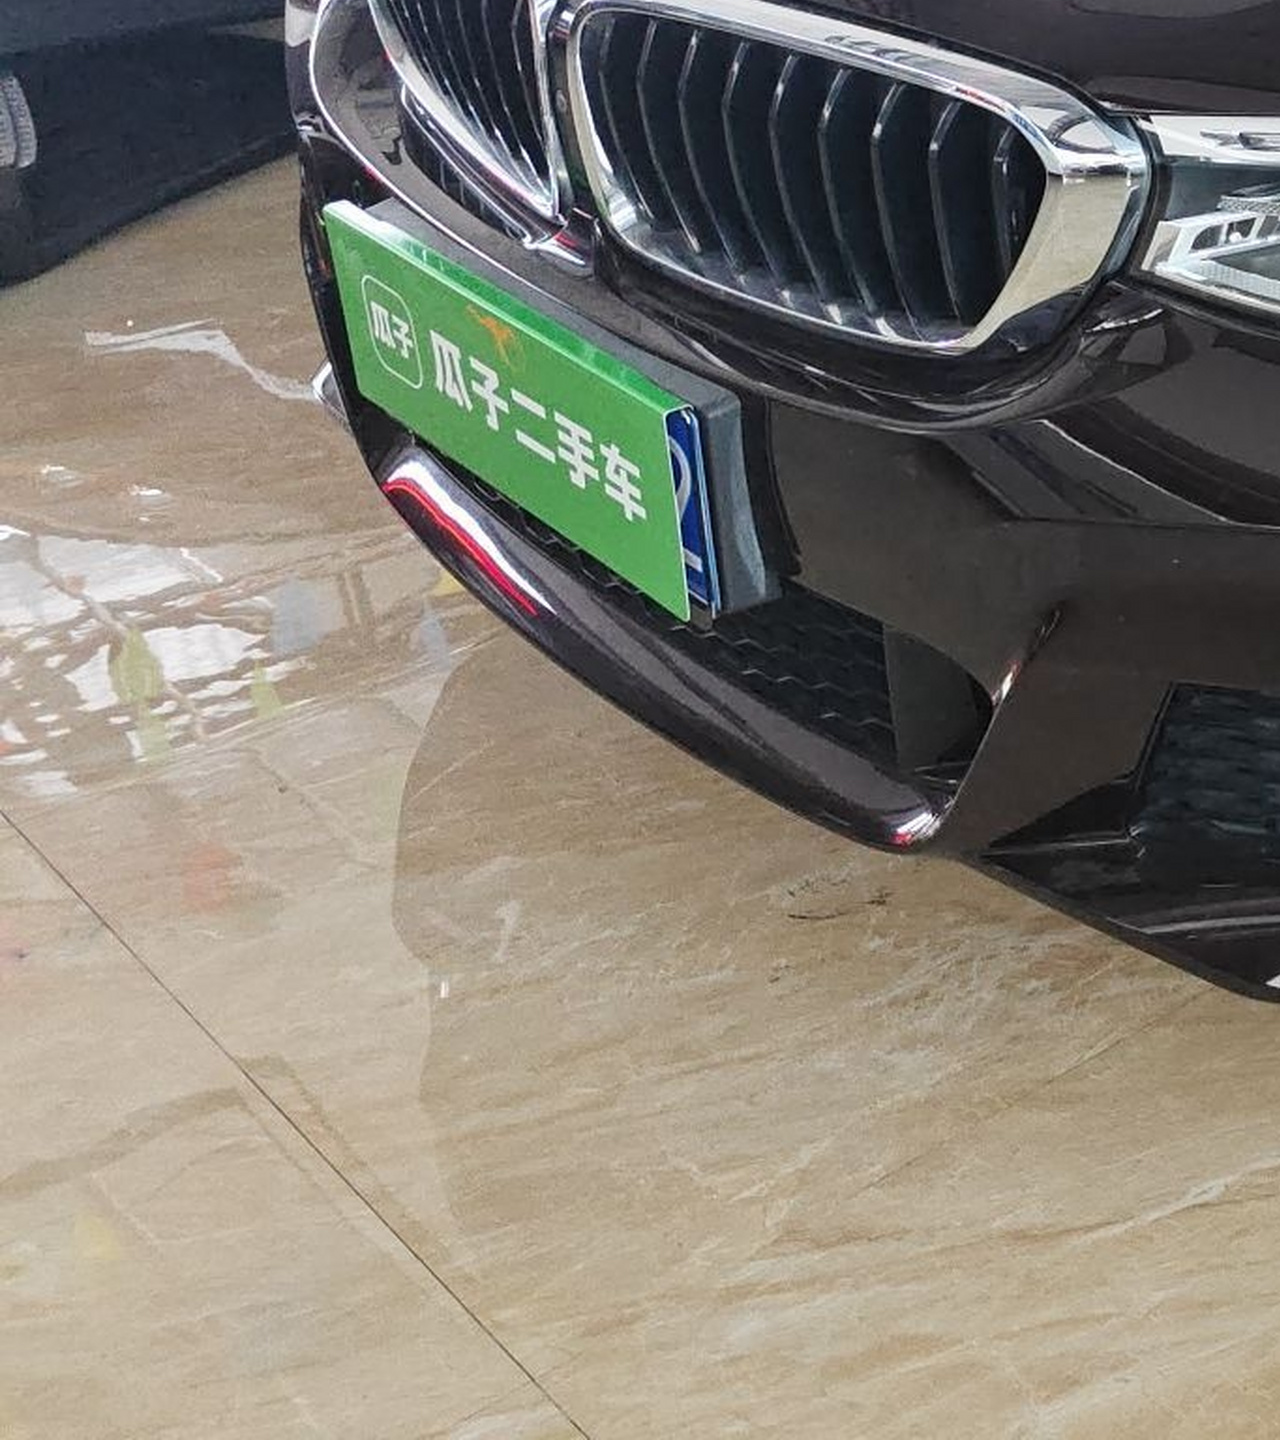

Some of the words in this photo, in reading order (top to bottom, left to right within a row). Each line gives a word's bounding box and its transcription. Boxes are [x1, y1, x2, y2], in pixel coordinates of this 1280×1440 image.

[369, 300, 414, 360] 瓜子
[430, 329, 647, 522] 瓜子二手车
